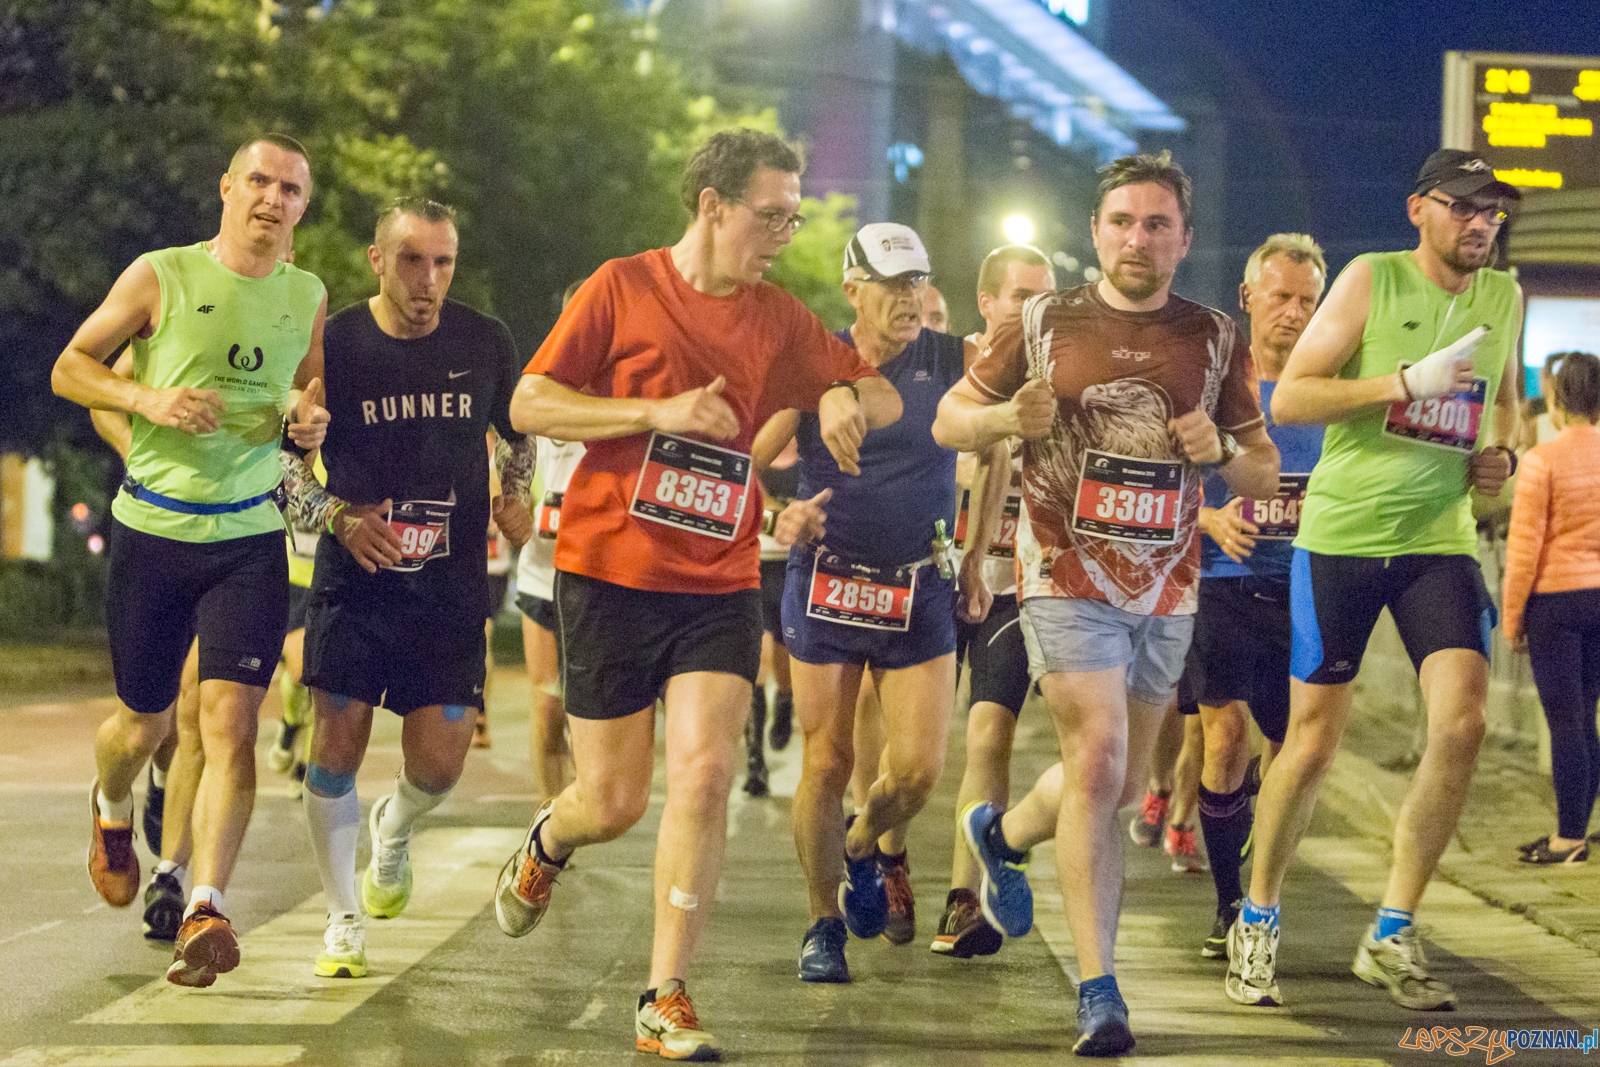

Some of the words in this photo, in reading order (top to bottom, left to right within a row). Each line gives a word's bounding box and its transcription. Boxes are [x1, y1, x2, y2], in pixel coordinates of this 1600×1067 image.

[197, 304, 215, 314] 4F
[214, 375, 225, 383] THE
[226, 377, 247, 386] WORLD
[248, 380, 268, 389] GAMES
[361, 392, 472, 425] RUNNER
[1403, 398, 1471, 434] 4300
[655, 469, 731, 517] 8353
[1095, 486, 1166, 524] 3381
[825, 578, 894, 614] 2859
